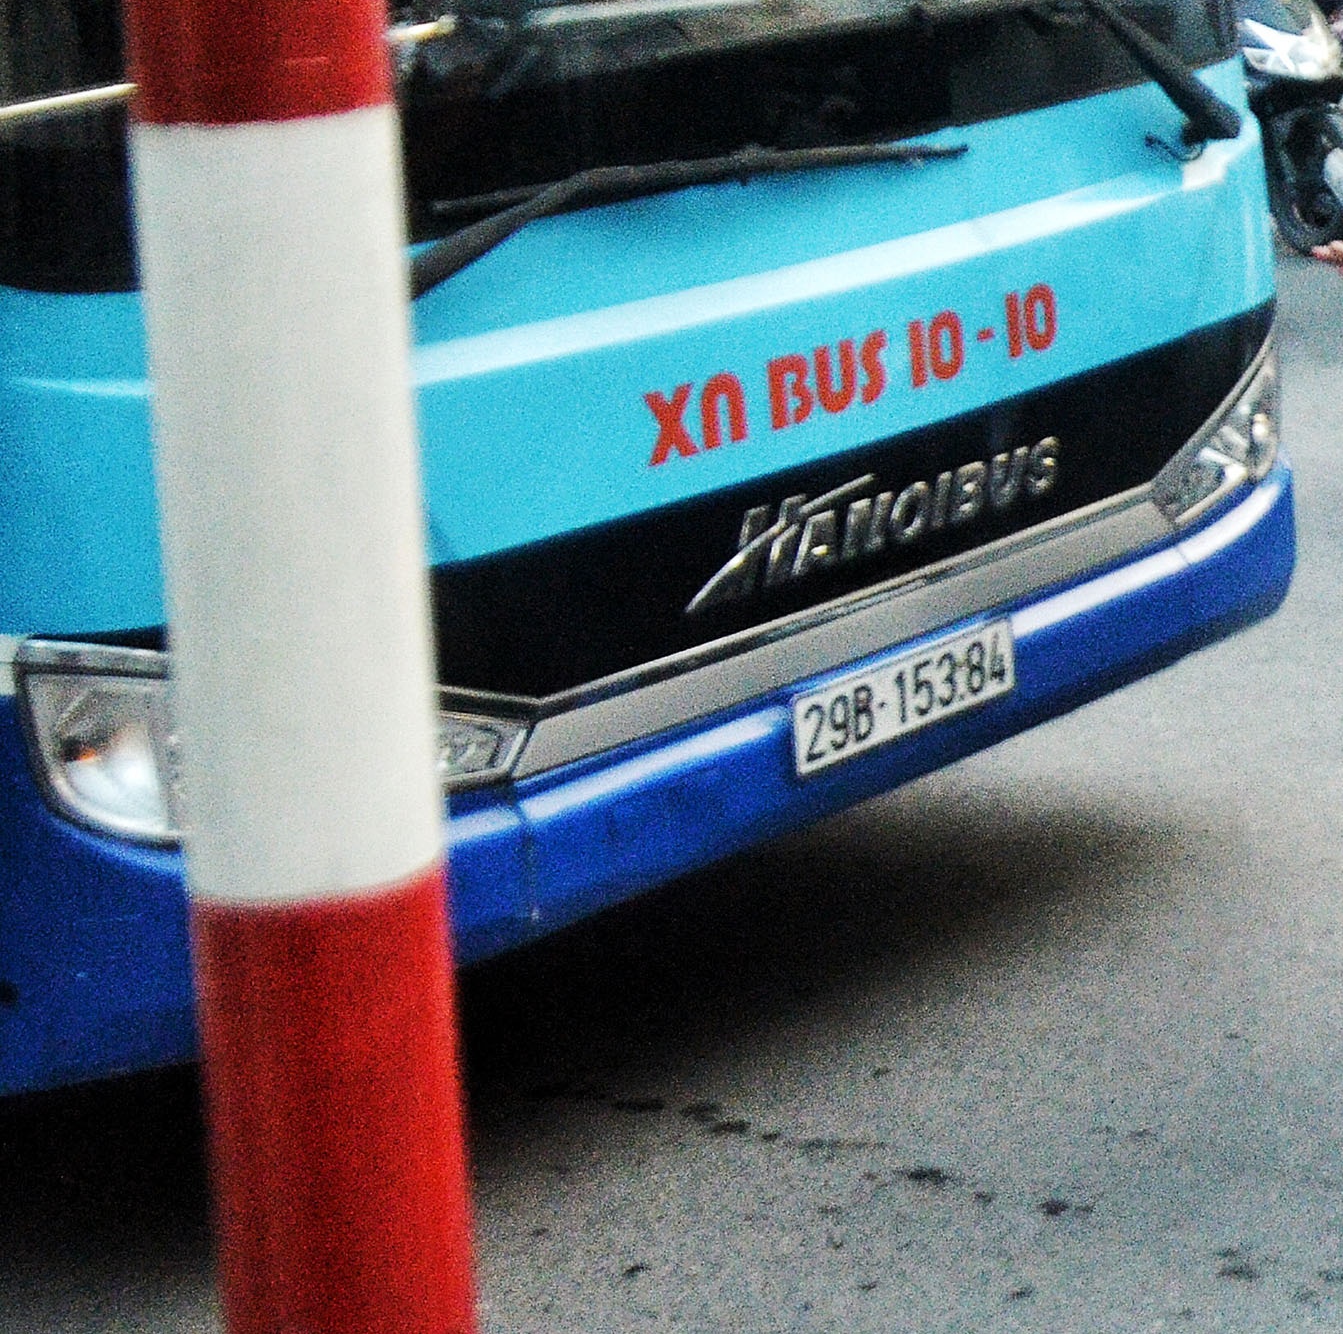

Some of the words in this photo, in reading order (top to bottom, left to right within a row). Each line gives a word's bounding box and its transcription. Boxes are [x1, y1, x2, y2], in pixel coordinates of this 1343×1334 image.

[766, 328, 888, 431] BUS
[907, 309, 964, 388] 10
[1003, 282, 1057, 359] 10
[803, 629, 1008, 763] 29B-153.84
